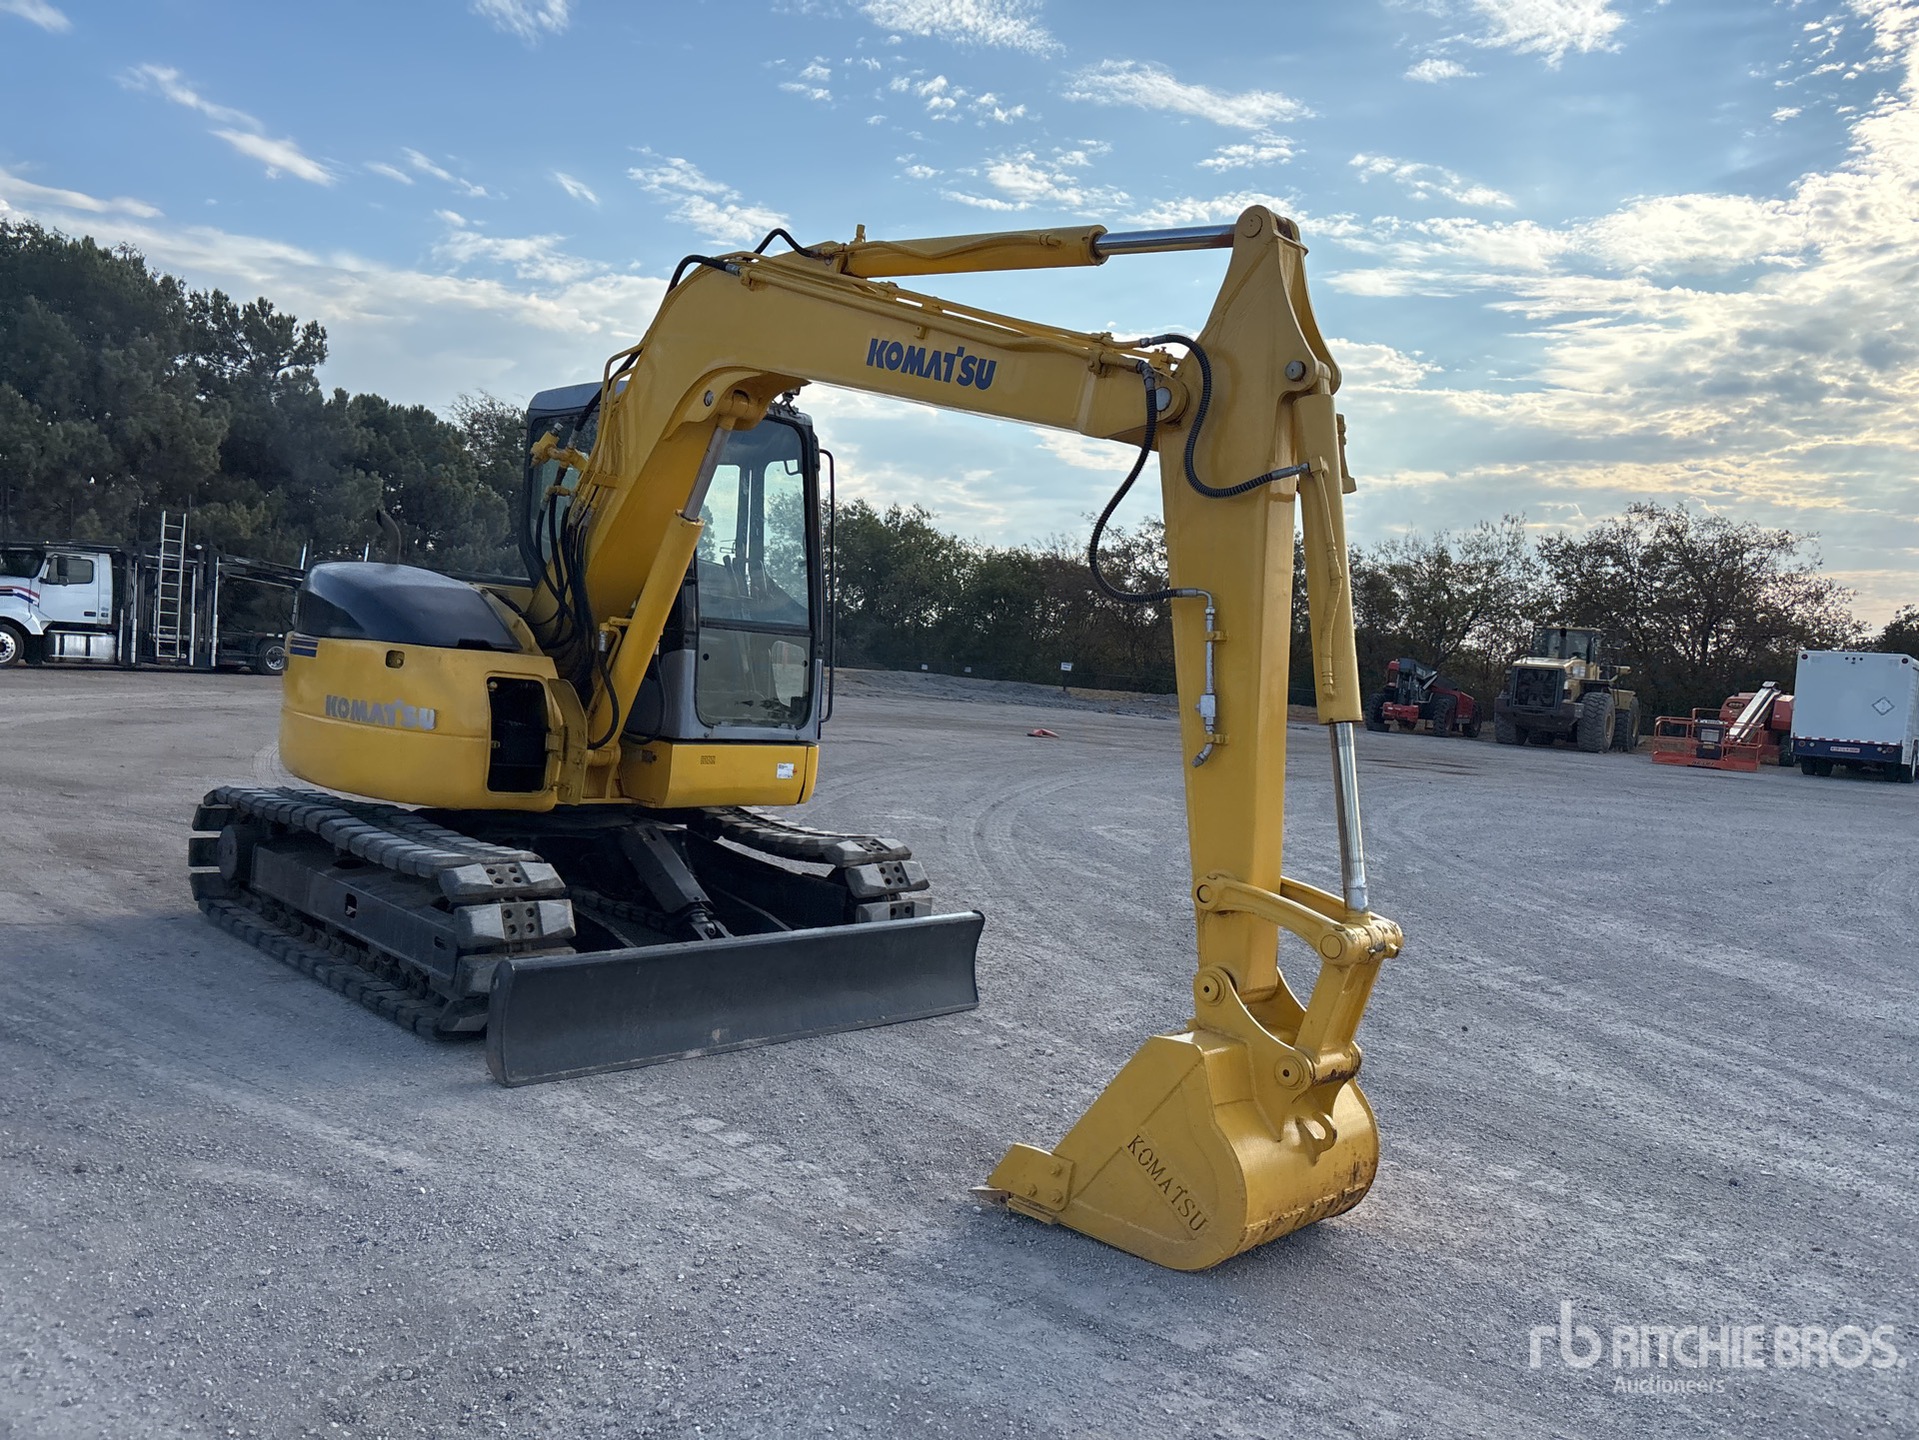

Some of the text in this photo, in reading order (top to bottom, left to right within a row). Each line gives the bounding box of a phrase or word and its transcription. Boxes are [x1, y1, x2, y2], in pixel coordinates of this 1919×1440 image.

[866, 338, 997, 390] KOMATSU
[325, 695, 437, 731] KOMATSU
[1127, 1134, 1208, 1231] KOMATSU
